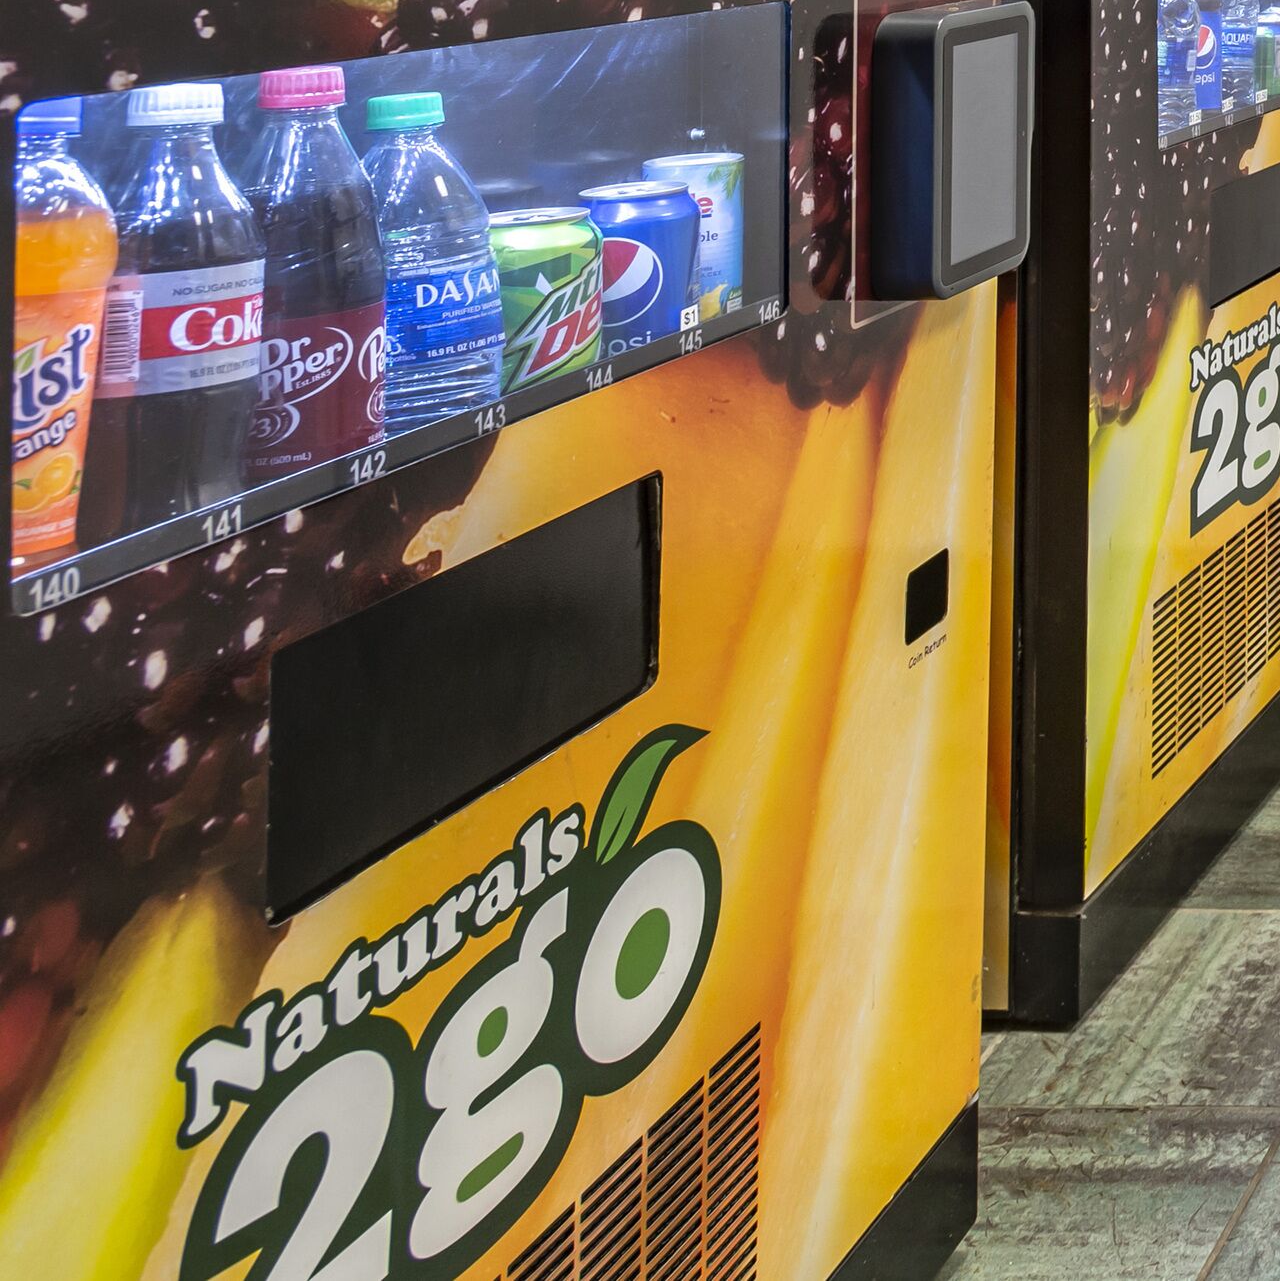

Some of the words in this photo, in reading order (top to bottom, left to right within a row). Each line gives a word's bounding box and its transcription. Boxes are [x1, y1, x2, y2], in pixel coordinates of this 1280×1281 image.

[172, 287, 193, 297] NO
[194, 279, 233, 295] SUGAR
[234, 280, 248, 289] NO
[442, 305, 481, 319] PURIFIED
[758, 300, 780, 324] 146
[259, 336, 312, 372] Dr
[426, 347, 445, 358] 16.9
[445, 345, 456, 355] FL
[457, 343, 468, 352] OZ
[679, 330, 702, 356] 145
[13, 325, 93, 420] ist
[586, 364, 614, 392] 144
[474, 404, 506, 437] 143
[350, 451, 387, 485] 142
[202, 505, 243, 543] 141
[28, 567, 80, 609] 140
[908, 652, 923, 669] Coin
[924, 633, 947, 658] Return
[187, 806, 584, 1133] Naturals
[214, 848, 706, 1281] 2go
